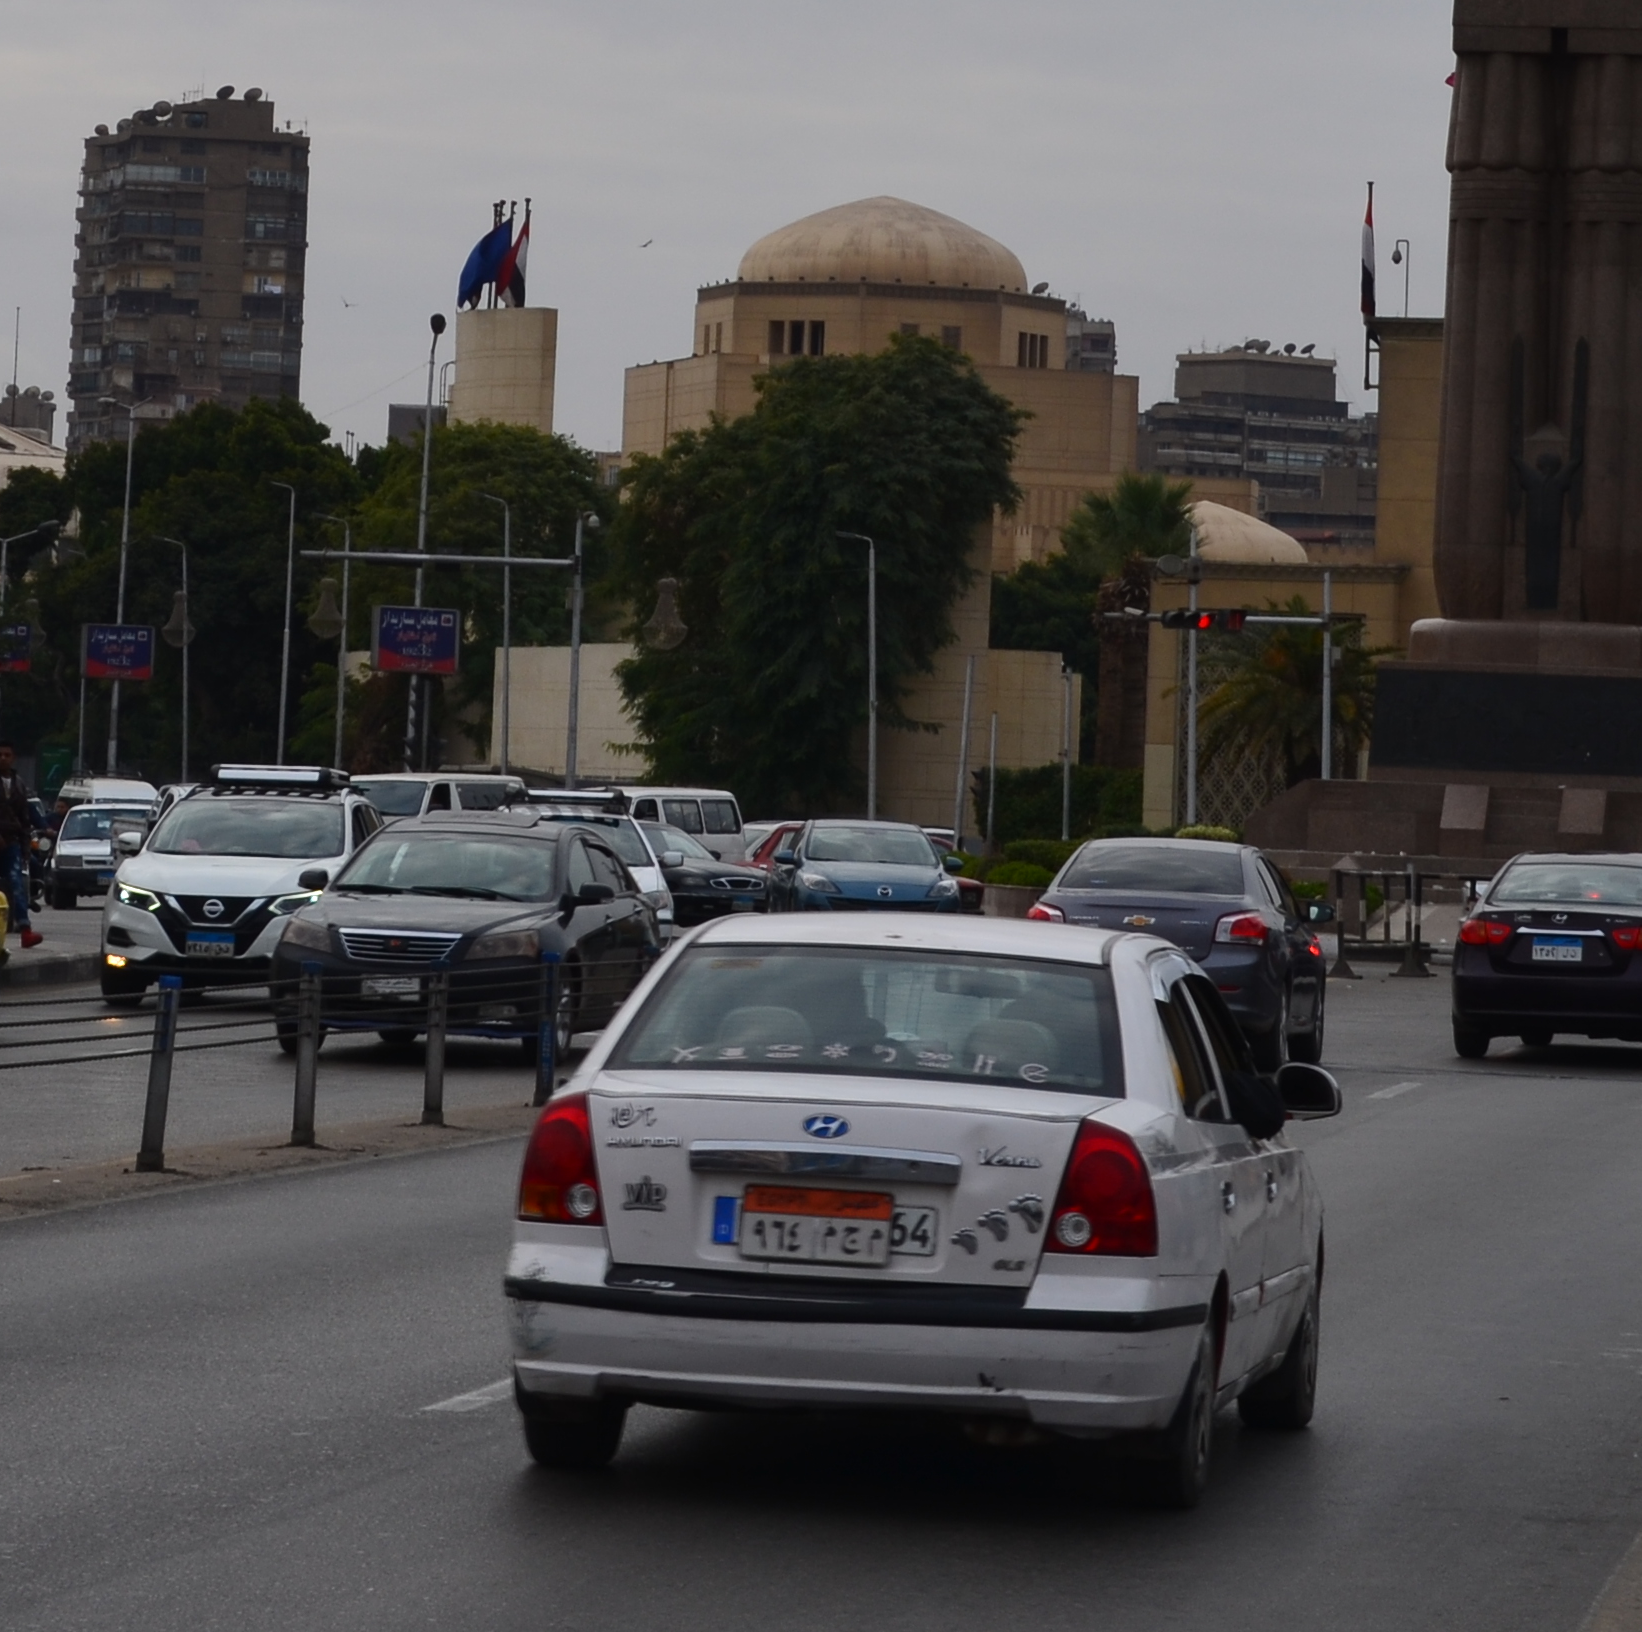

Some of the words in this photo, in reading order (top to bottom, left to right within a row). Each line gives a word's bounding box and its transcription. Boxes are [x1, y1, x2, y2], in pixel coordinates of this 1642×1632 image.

[606, 1136, 682, 1148] HYUNDAI
[978, 1145, 1042, 1169] Verna
[623, 1176, 668, 1204] VIP
